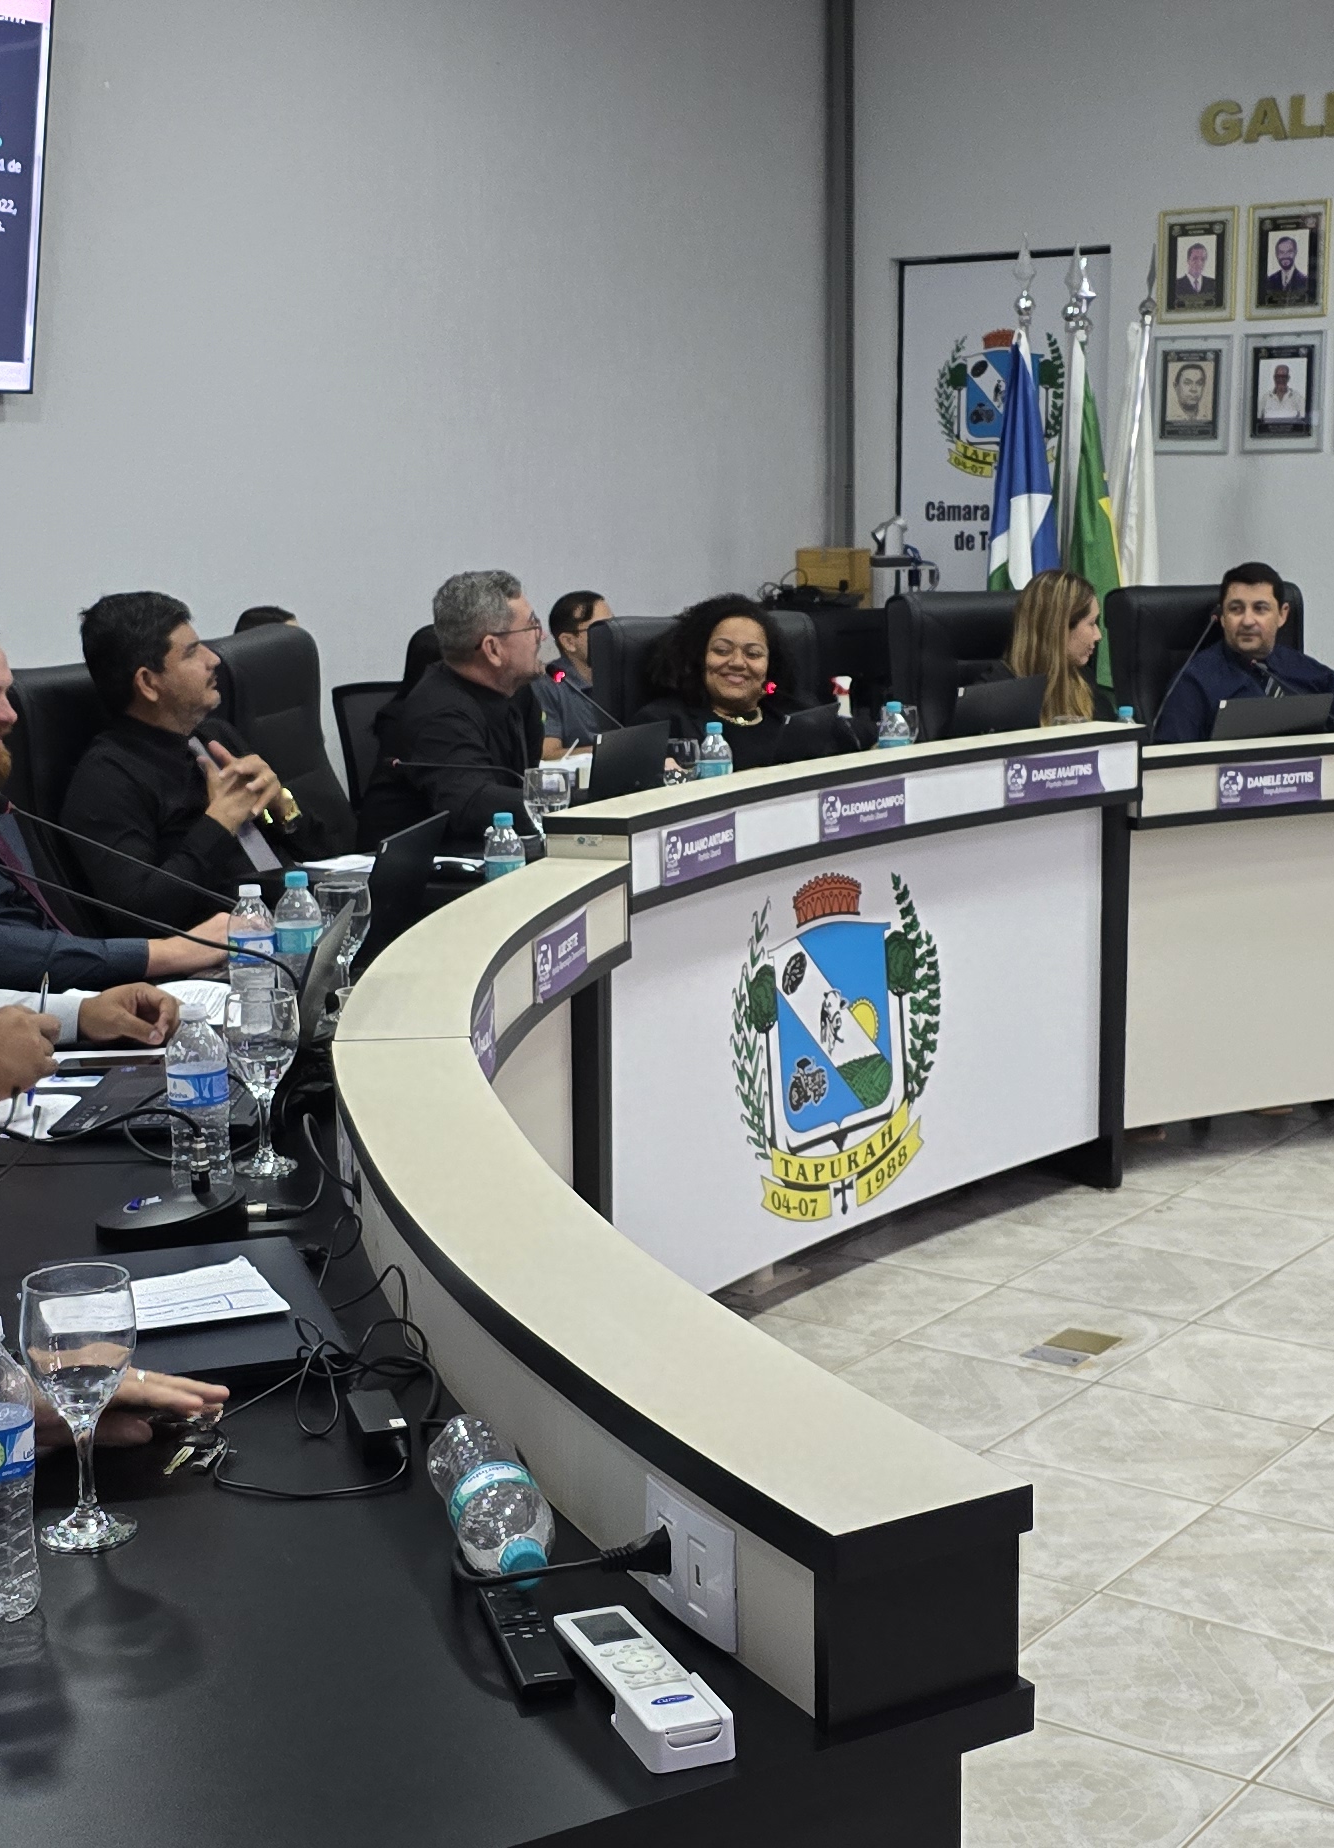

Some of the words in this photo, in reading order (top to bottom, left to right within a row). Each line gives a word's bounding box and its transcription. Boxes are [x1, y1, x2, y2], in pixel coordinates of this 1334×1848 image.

[7, 159, 22, 173] de
[925, 500, 990, 522] Câmara
[954, 530, 975, 551] de
[1247, 773, 1281, 789] DANIELE
[1282, 771, 1314, 785] ZOTTIS
[841, 799, 876, 817] CLEOMAR
[876, 794, 904, 810] CAMPOS
[683, 837, 708, 856] JULIANO
[779, 1123, 894, 1182] TAPURAH
[771, 1190, 818, 1217] 04-07
[865, 1144, 908, 1199] 1988
